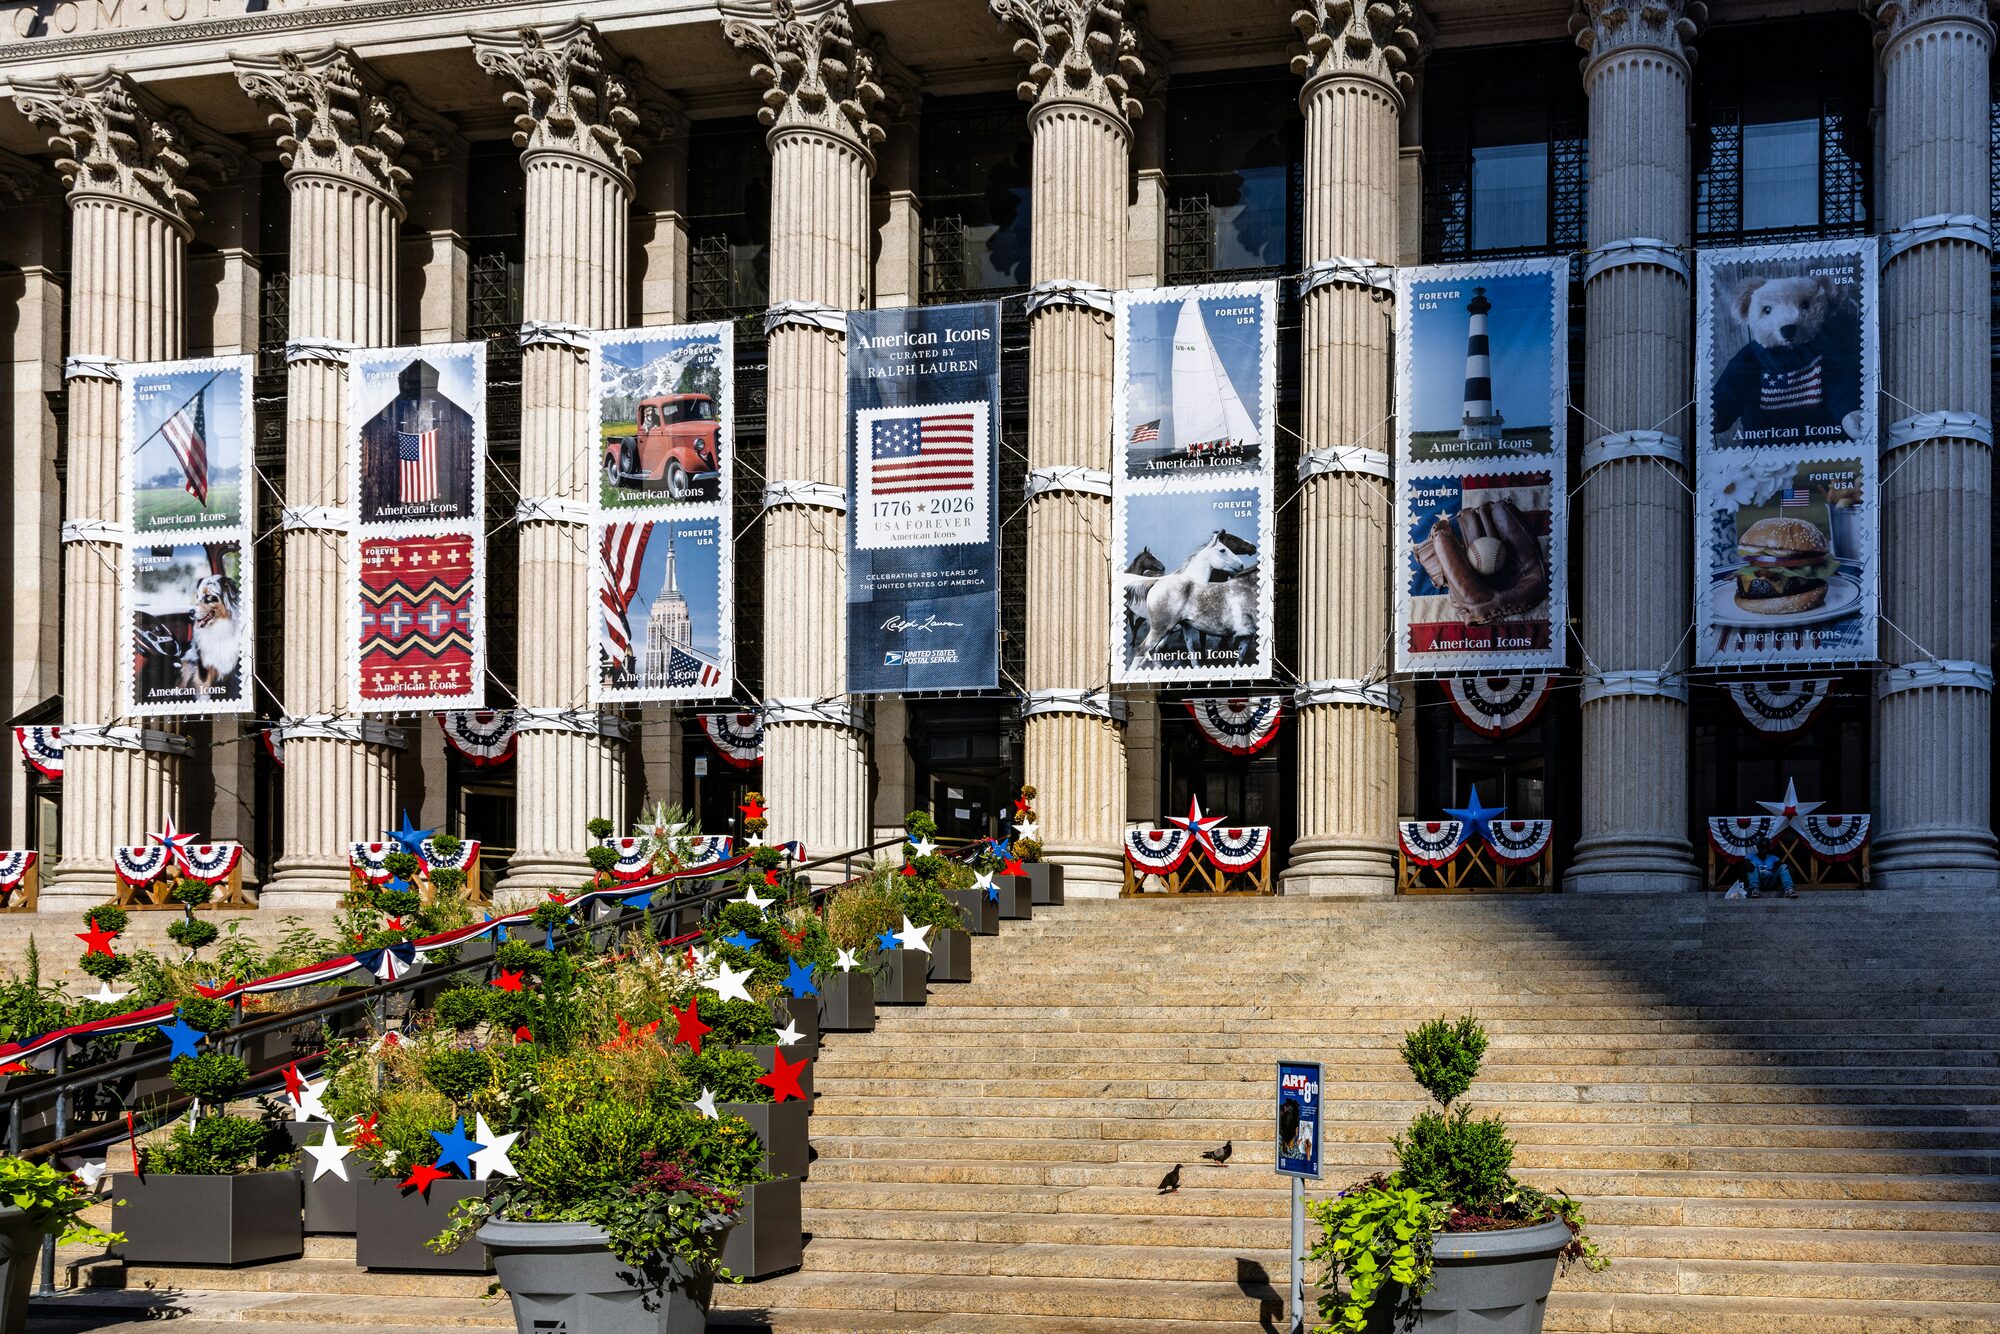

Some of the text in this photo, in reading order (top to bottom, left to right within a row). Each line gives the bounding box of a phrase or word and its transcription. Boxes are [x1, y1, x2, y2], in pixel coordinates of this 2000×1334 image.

[1810, 267, 1854, 276] FOREVER
[1835, 276, 1854, 284] USA
[1419, 291, 1460, 300] FOREVER
[1216, 307, 1255, 316] FOREVER
[1419, 302, 1437, 310] USA
[857, 328, 990, 349] American Icons
[678, 347, 714, 356] FOREVER
[890, 349, 955, 360] CURATED BY
[868, 360, 978, 378] RALPH LAUREN
[140, 384, 171, 392] FOREVER
[1733, 425, 1842, 440] American Icons
[1430, 438, 1533, 452] American Icons
[1145, 456, 1242, 470] American Icons
[1809, 472, 1854, 481] FOREVER
[1834, 481, 1854, 489] USA
[618, 487, 704, 501] American Icons
[375, 502, 458, 515] American Icons
[872, 497, 974, 517] 1776 2026
[1213, 501, 1252, 509] FOREVER
[1417, 499, 1435, 507] USA
[148, 512, 226, 525] American Icons
[875, 518, 971, 531] USA FOREVER
[890, 531, 956, 541] American Icons
[366, 556, 380, 564] USA
[908, 580, 935, 588] STATES
[1734, 629, 1841, 643] American Icons
[1428, 637, 1531, 650] American Icons
[1144, 649, 1240, 661] American Icons
[617, 670, 669, 682] American
[148, 685, 226, 697] American Icons
[375, 681, 457, 692] American Icons
[1282, 1075, 1306, 1087] ART
[1304, 1082, 1318, 1103] 8th
